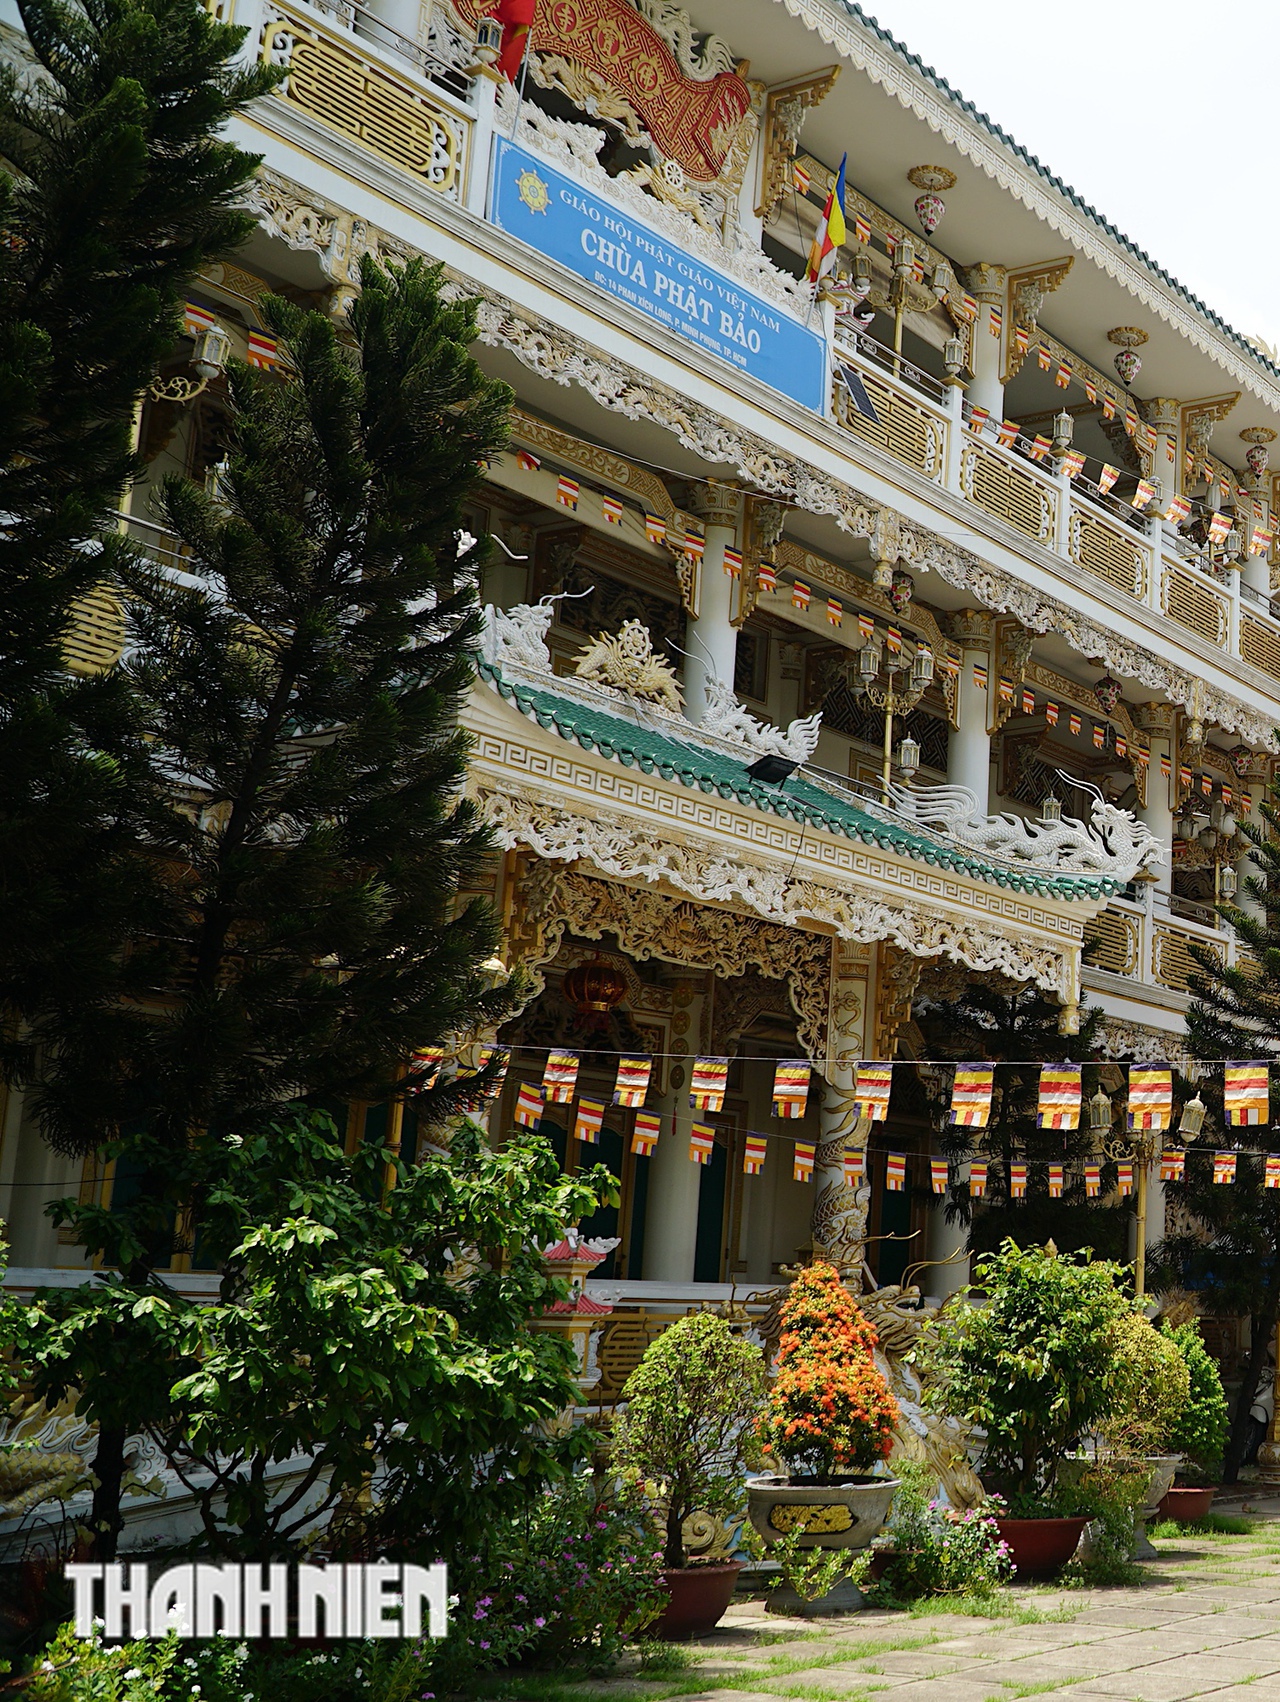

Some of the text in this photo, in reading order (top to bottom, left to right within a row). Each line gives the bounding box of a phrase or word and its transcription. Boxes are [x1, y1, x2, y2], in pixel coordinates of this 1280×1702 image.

[560, 189, 780, 334] GIÁO HỘI PHẬT GIÁO VIỆT NAM
[581, 228, 761, 354] CHÙA PHẬT BẢO
[608, 278, 617, 291] 14
[617, 284, 637, 303] PHAN
[638, 296, 654, 313] XÍCH
[681, 321, 698, 339] MINH
[732, 351, 747, 367] HCM
